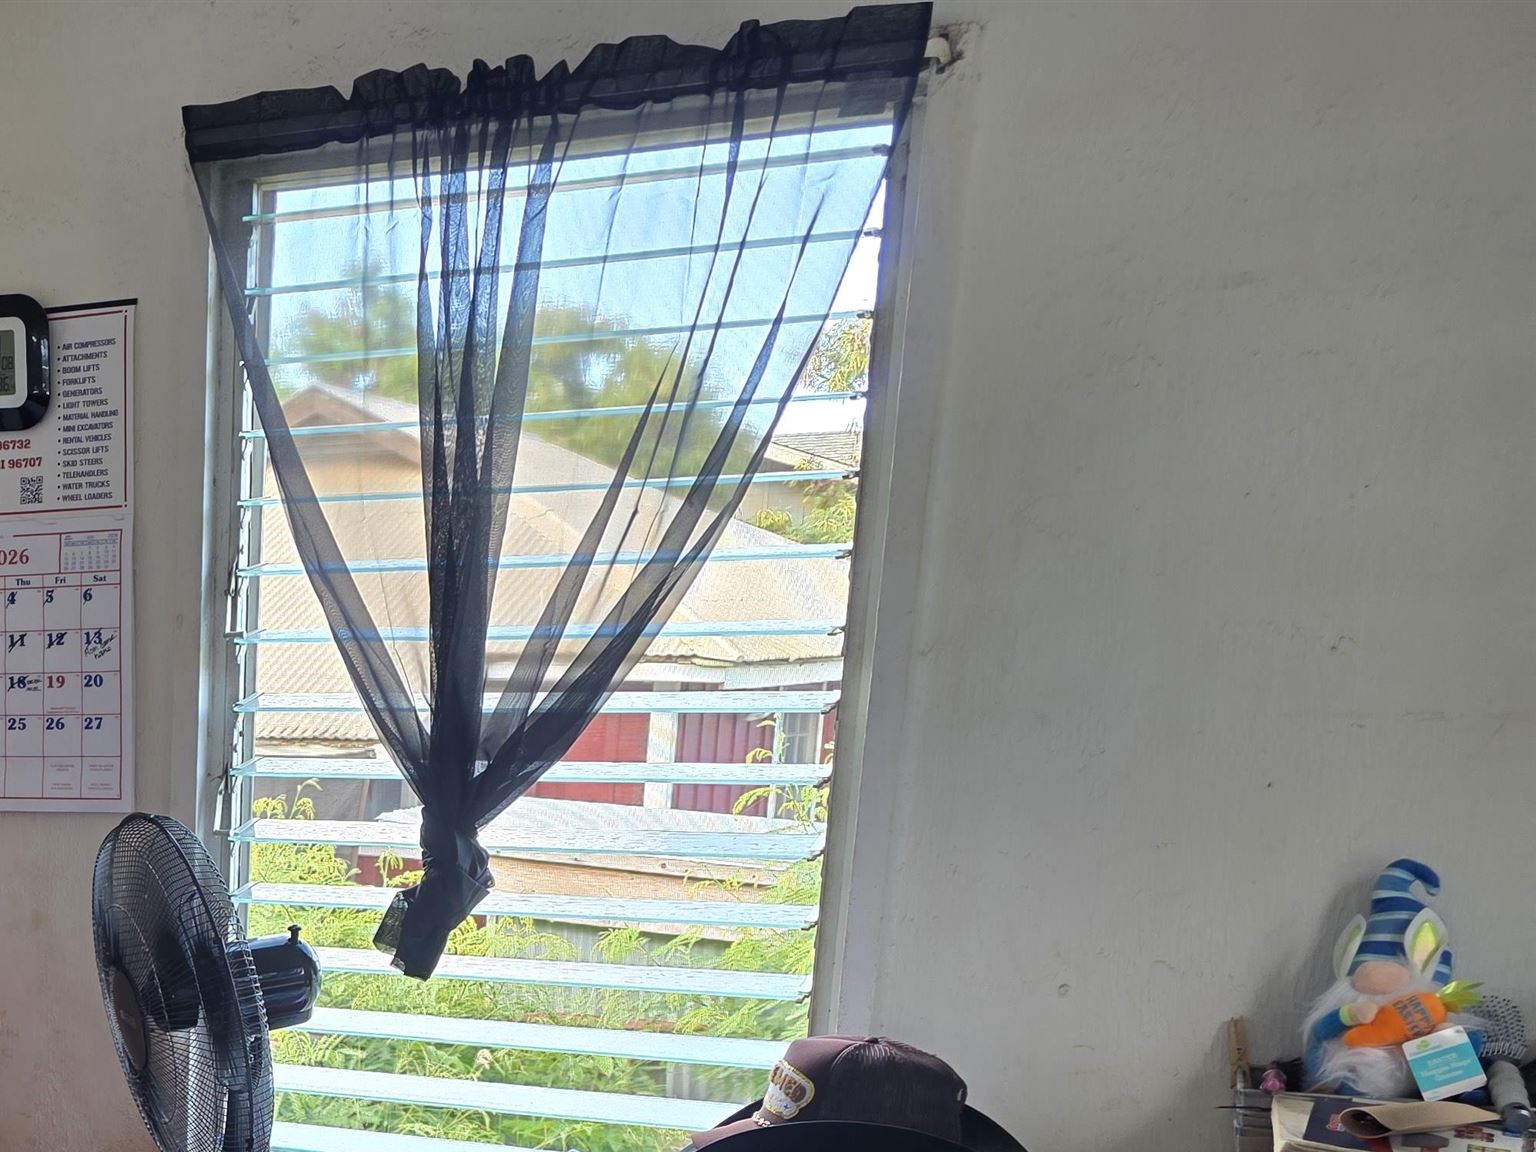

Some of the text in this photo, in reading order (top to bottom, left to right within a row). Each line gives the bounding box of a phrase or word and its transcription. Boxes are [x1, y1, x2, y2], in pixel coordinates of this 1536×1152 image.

[62, 350, 108, 362] ATTACHMENTS
[62, 363, 100, 374] BOOM LIFTS
[62, 375, 96, 386] FORKLIFTS
[62, 387, 103, 398] GENERATORS
[62, 445, 109, 456] SCISSOR LIFTS
[8, 456, 43, 469] 96707
[62, 480, 111, 490] WATER TRUCKS
[84, 491, 113, 501] LOADERS
[15, 578, 31, 586] Thu
[54, 576, 66, 585] Fri
[93, 574, 107, 583] Sat
[47, 675, 66, 689] 19
[84, 674, 104, 688] 20
[7, 717, 27, 730] 25
[45, 717, 65, 730] 26
[84, 716, 103, 730] 27
